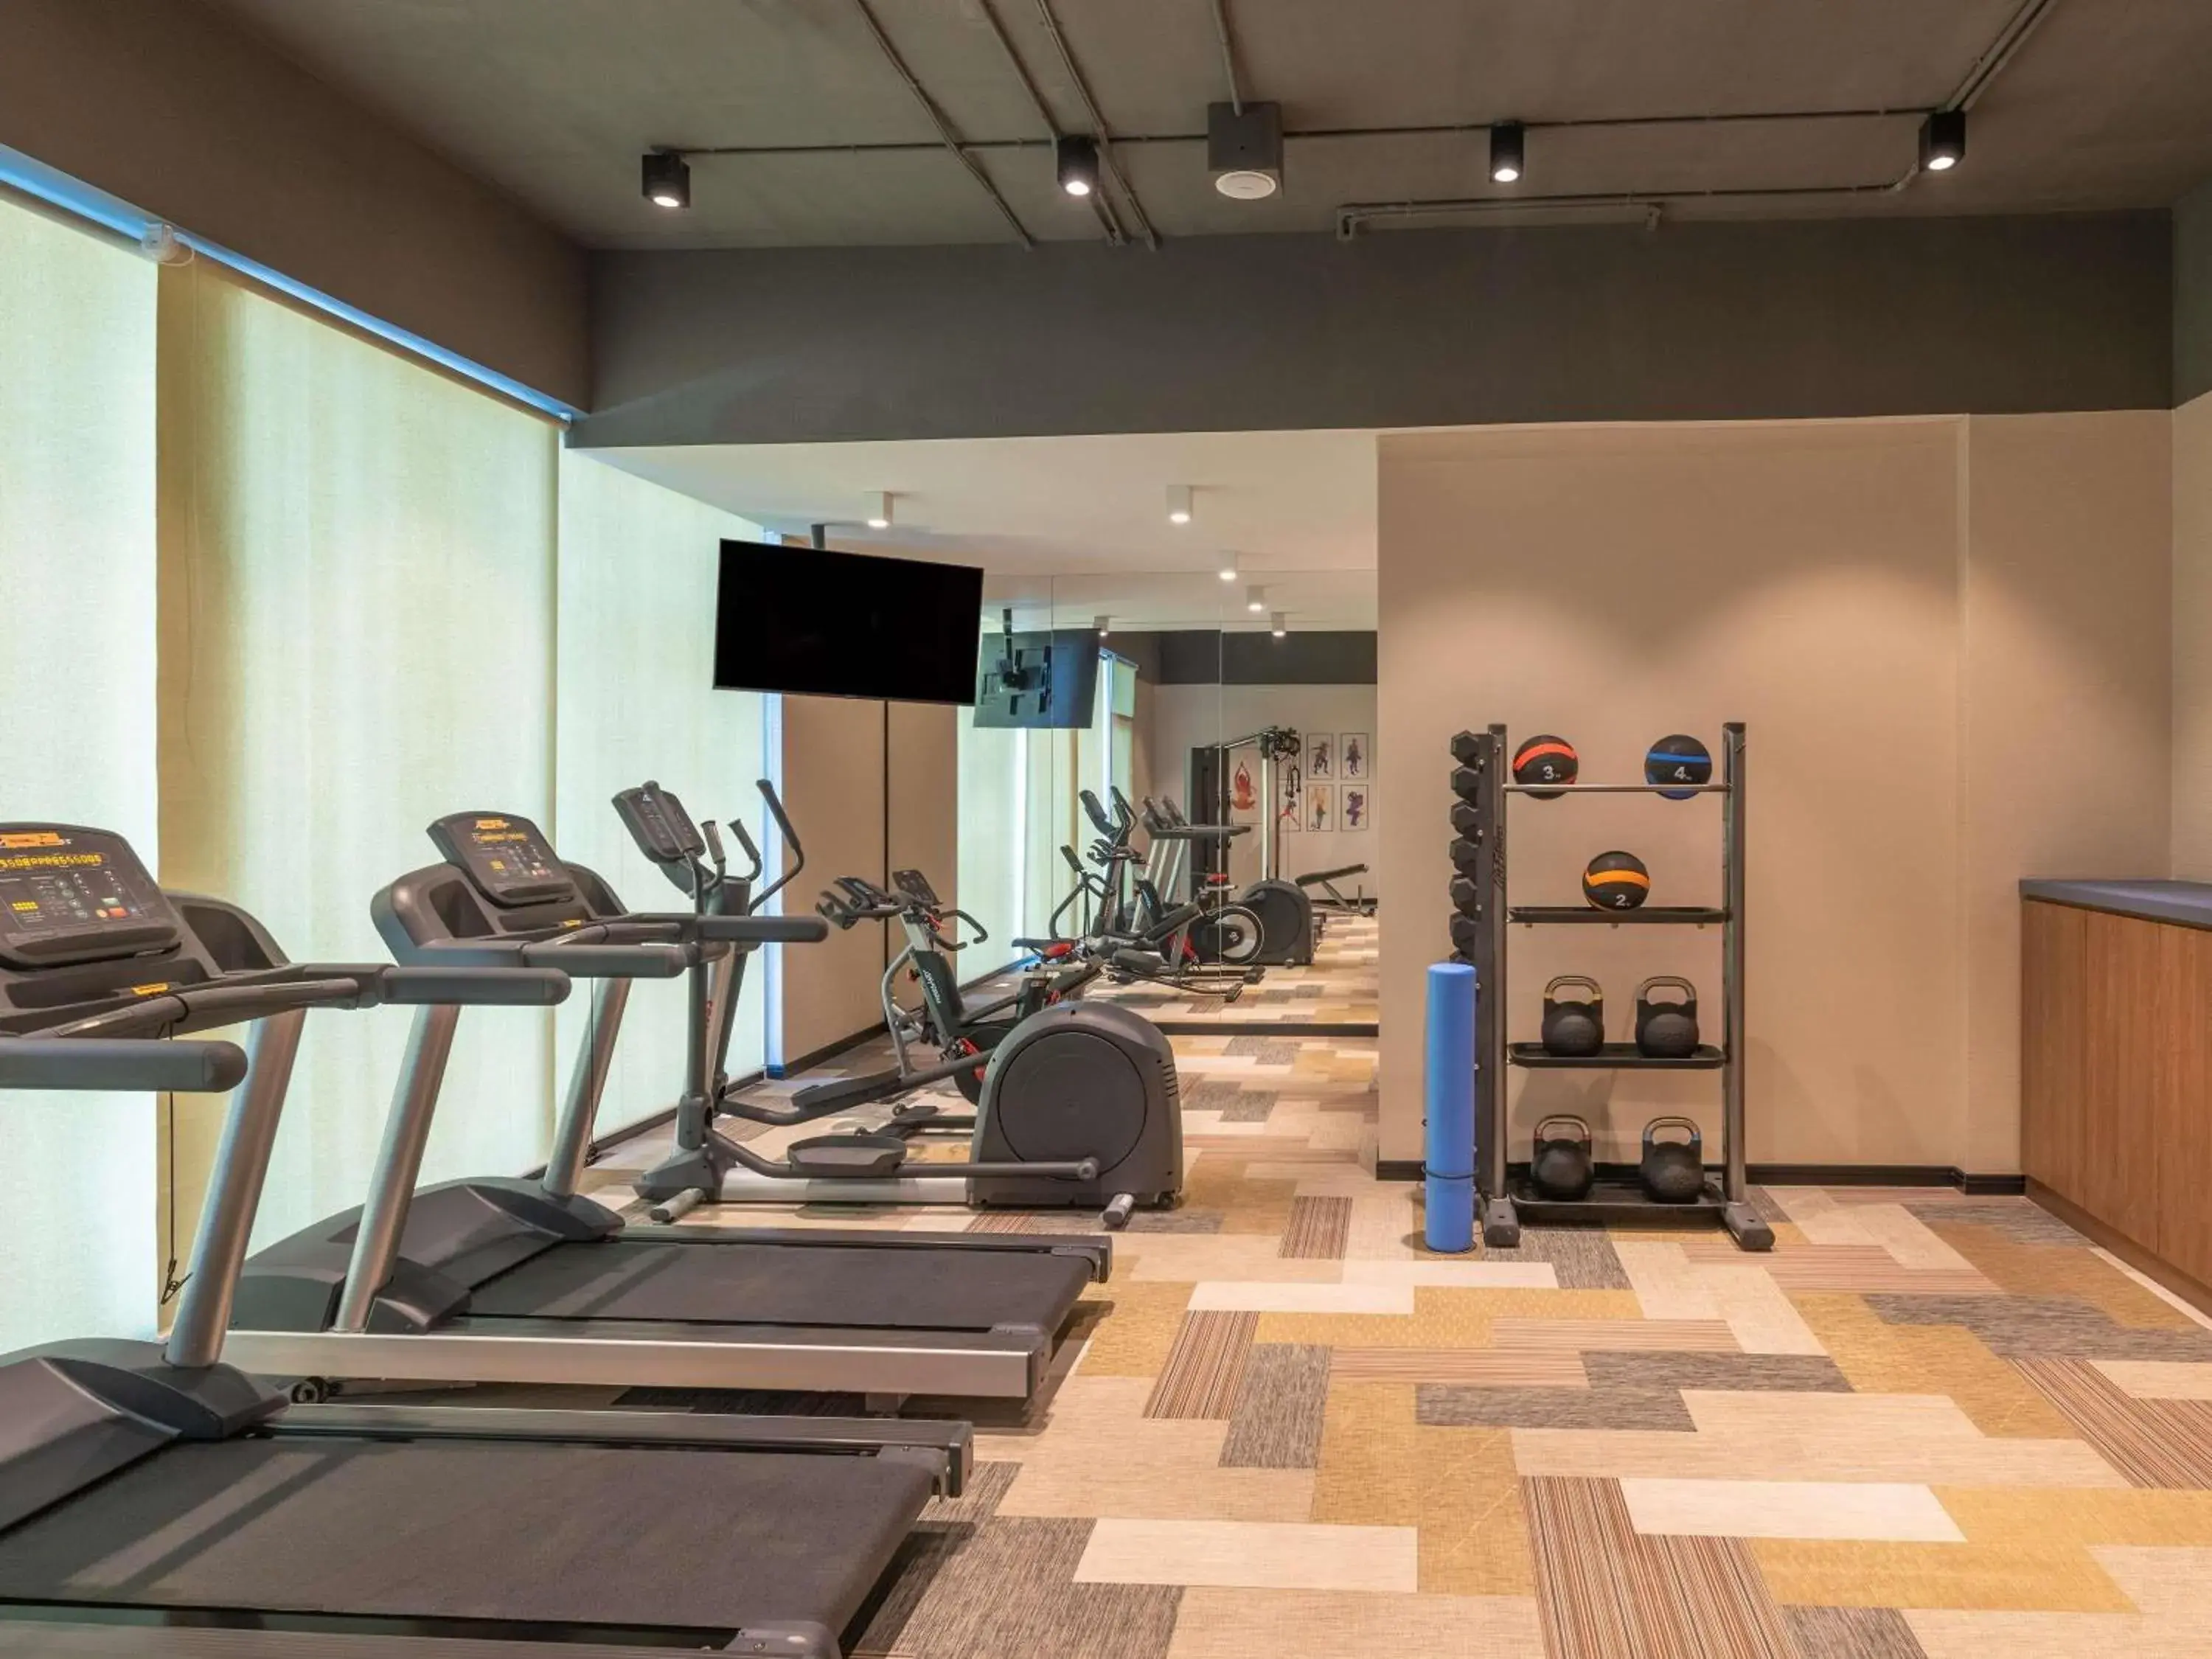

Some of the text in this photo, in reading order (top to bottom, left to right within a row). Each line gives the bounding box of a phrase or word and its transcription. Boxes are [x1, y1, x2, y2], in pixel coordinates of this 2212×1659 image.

[1543, 765, 1555, 780] 3
[1674, 765, 1686, 780] 4
[1615, 894, 1627, 906] 2
